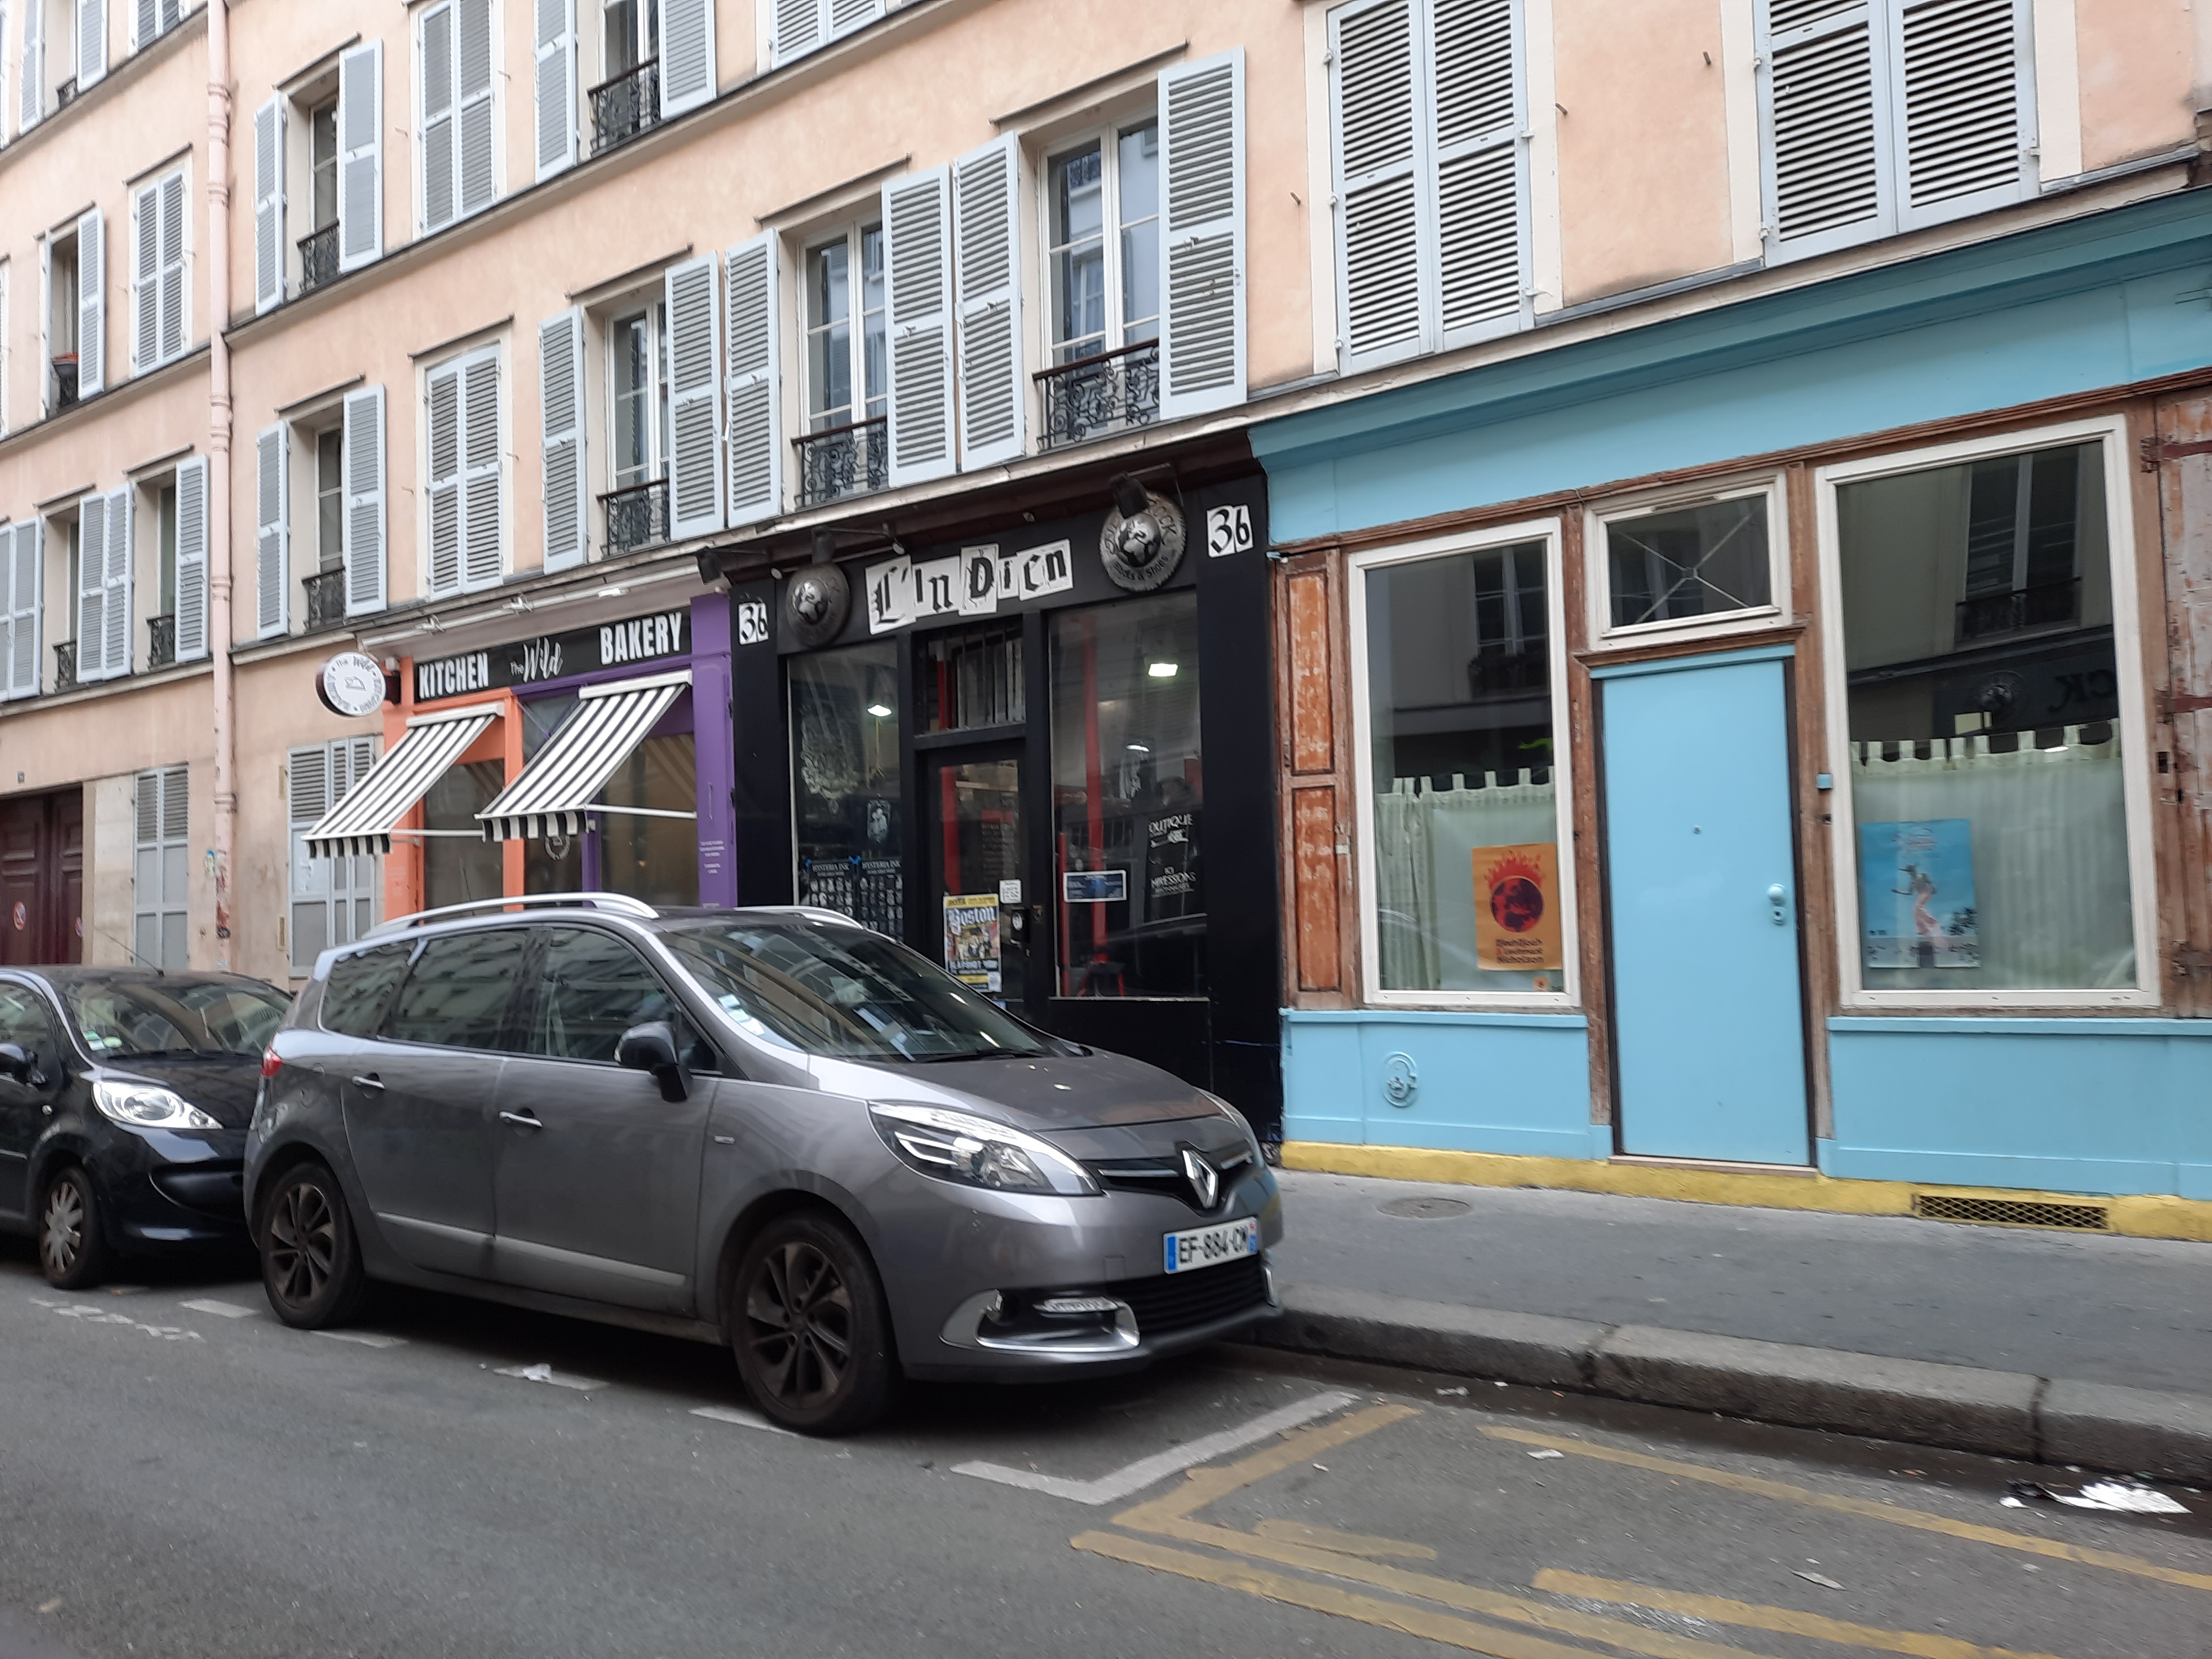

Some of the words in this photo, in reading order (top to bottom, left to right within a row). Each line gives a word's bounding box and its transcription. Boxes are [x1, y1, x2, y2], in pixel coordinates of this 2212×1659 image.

[1209, 508, 1250, 554] 36
[599, 611, 682, 665] BAKERY
[741, 605, 768, 641] 36
[419, 652, 489, 700] KITCHEN
[523, 637, 564, 684] Wild
